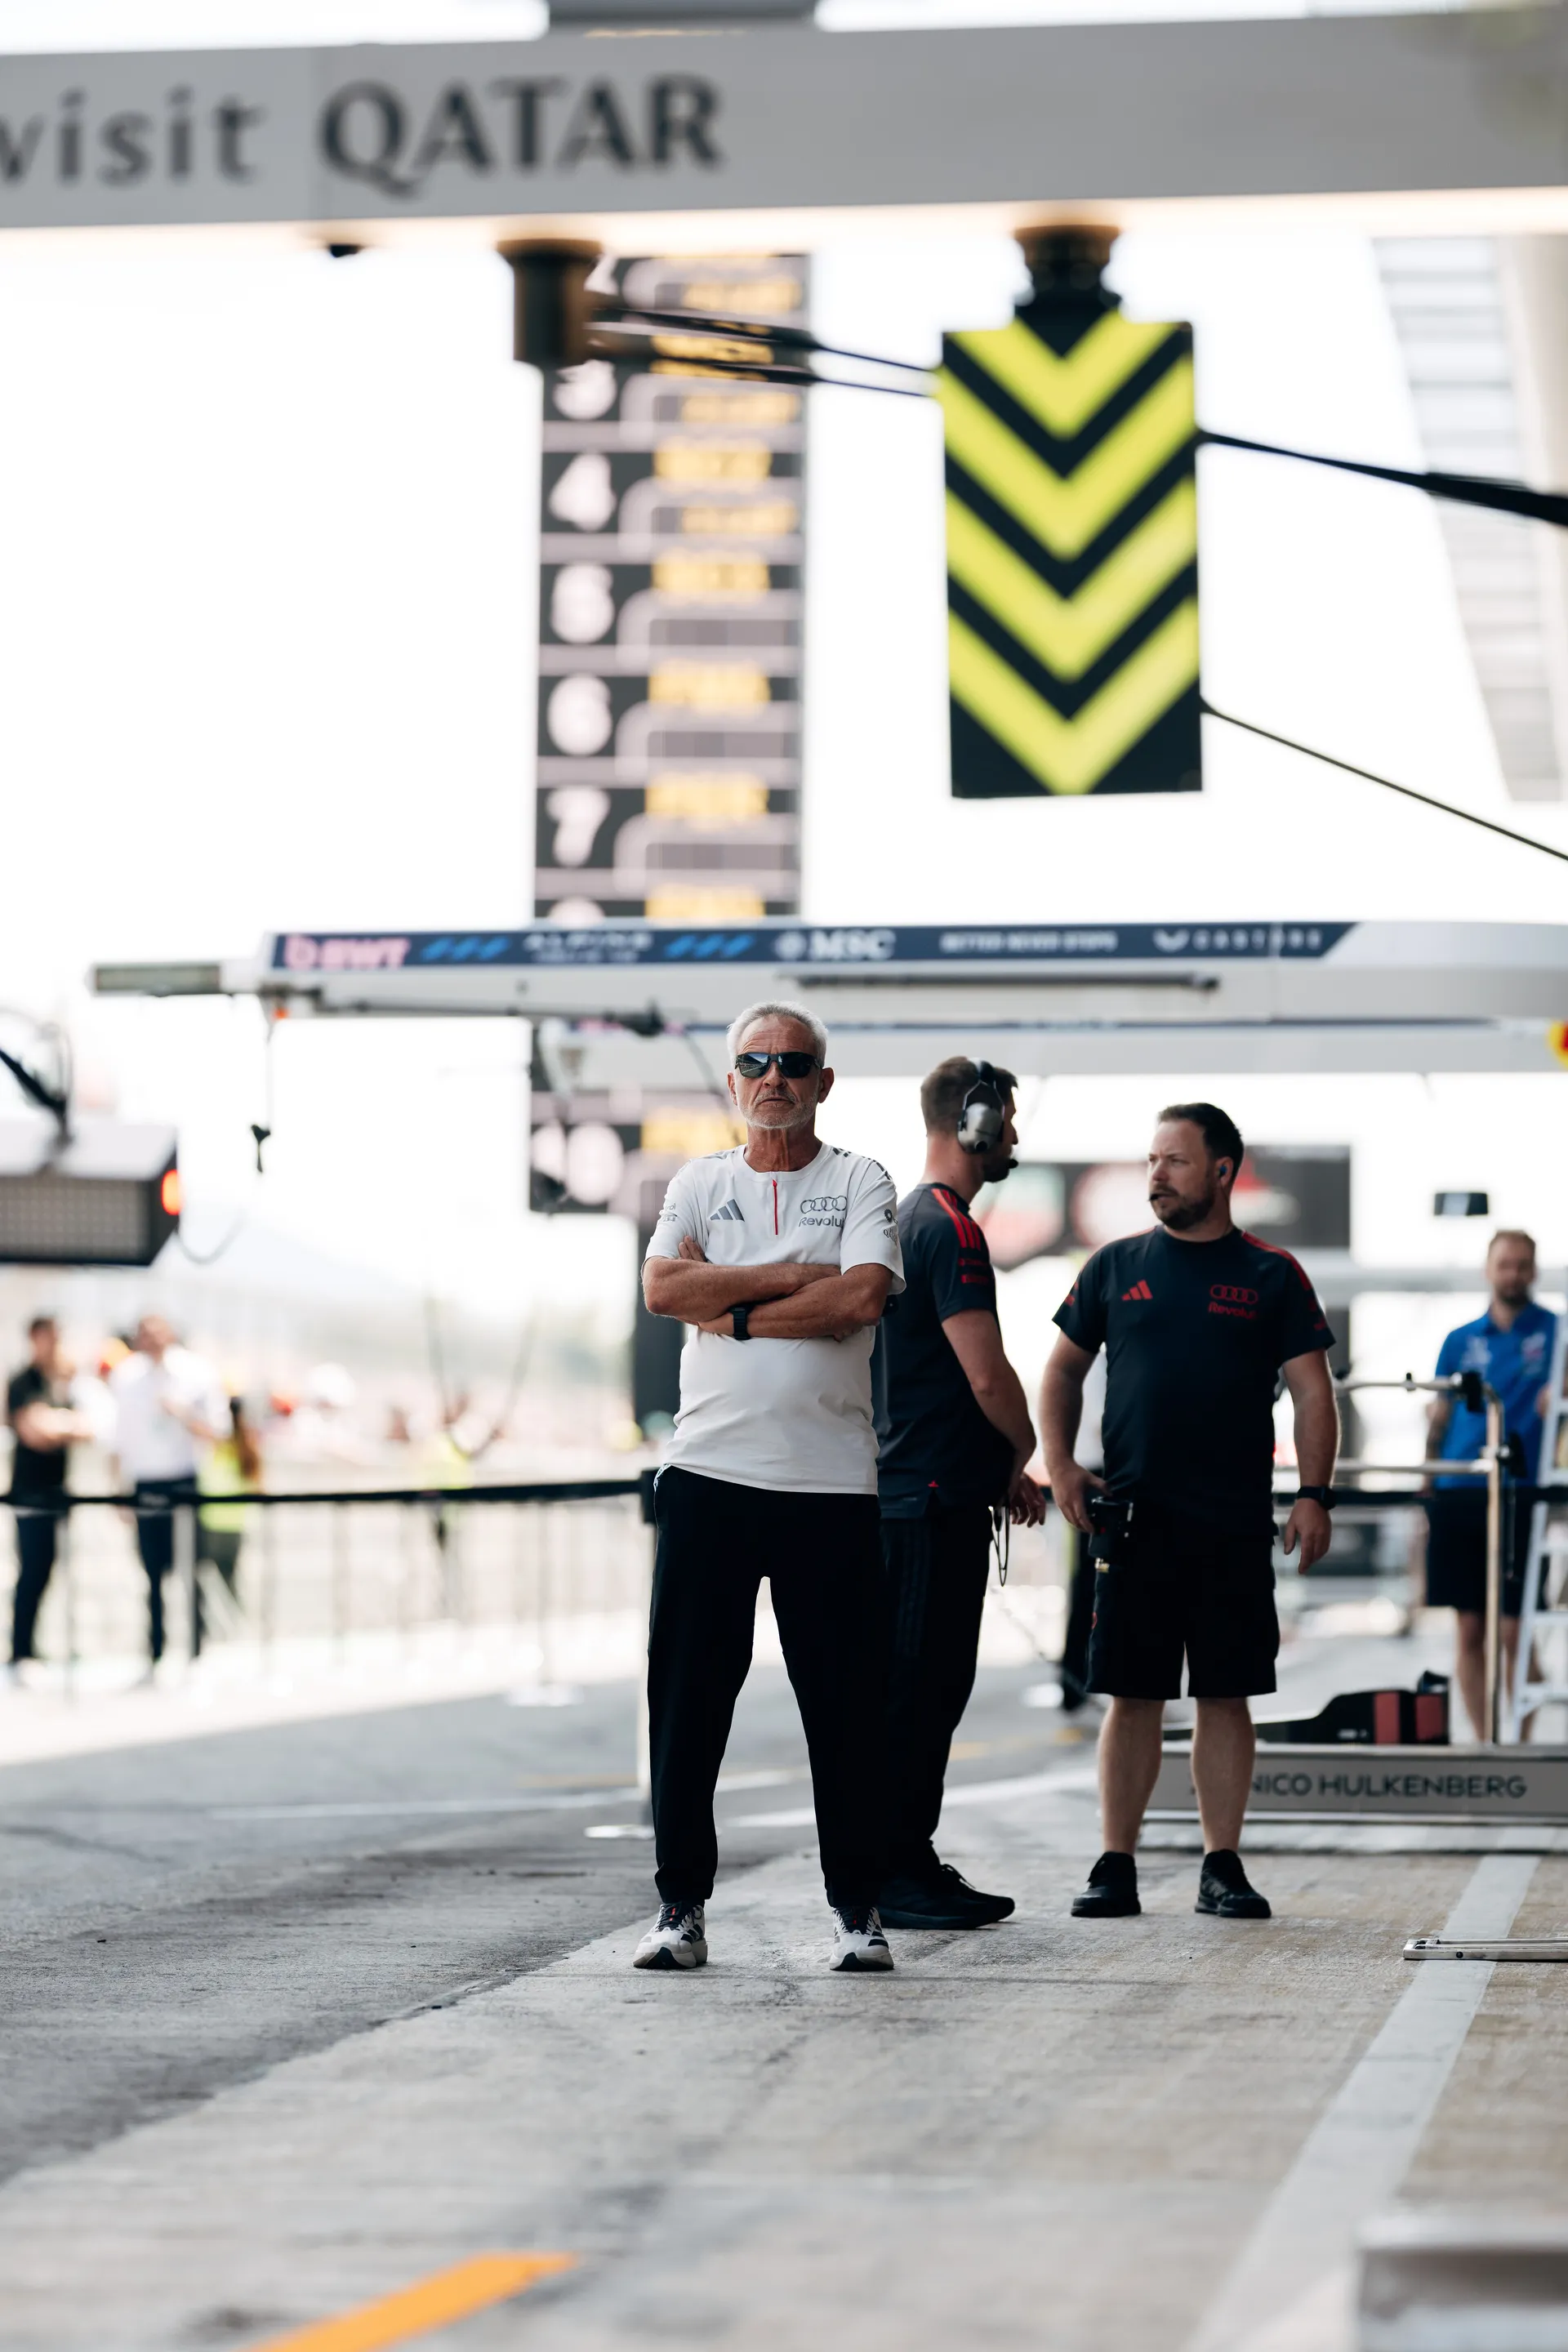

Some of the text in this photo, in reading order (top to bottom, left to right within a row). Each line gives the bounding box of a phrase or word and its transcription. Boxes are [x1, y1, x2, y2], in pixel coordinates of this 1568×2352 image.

[0, 72, 724, 201] visit QATAR
[544, 782, 612, 868] 7
[808, 928, 897, 960] MSC
[1318, 1774, 1527, 1798] HULKENBERG
